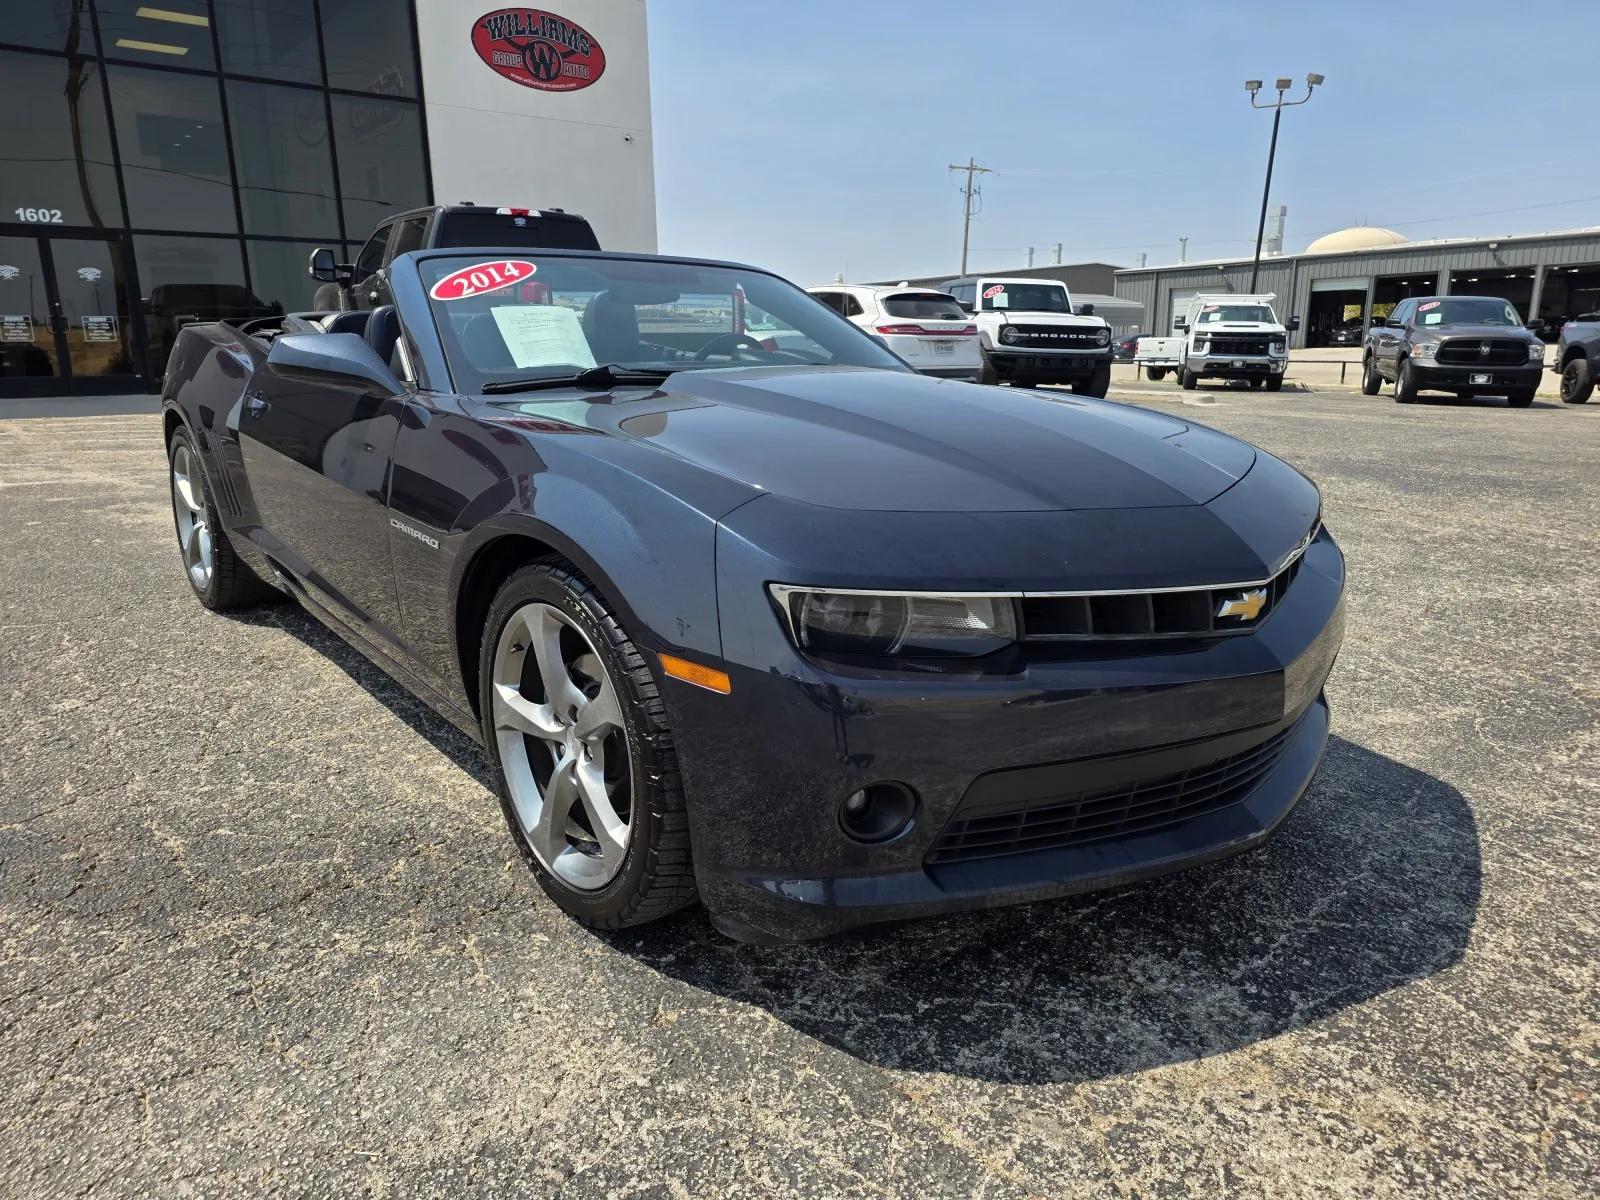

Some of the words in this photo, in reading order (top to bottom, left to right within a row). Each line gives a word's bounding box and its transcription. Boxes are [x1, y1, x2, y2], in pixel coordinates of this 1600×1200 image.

[486, 13, 591, 57] WILLIAMS
[492, 50, 523, 68] GROUP
[562, 62, 590, 79] AUTO
[15, 207, 63, 223] 1602
[452, 262, 520, 296] 2014
[390, 518, 439, 549] CAMARO
